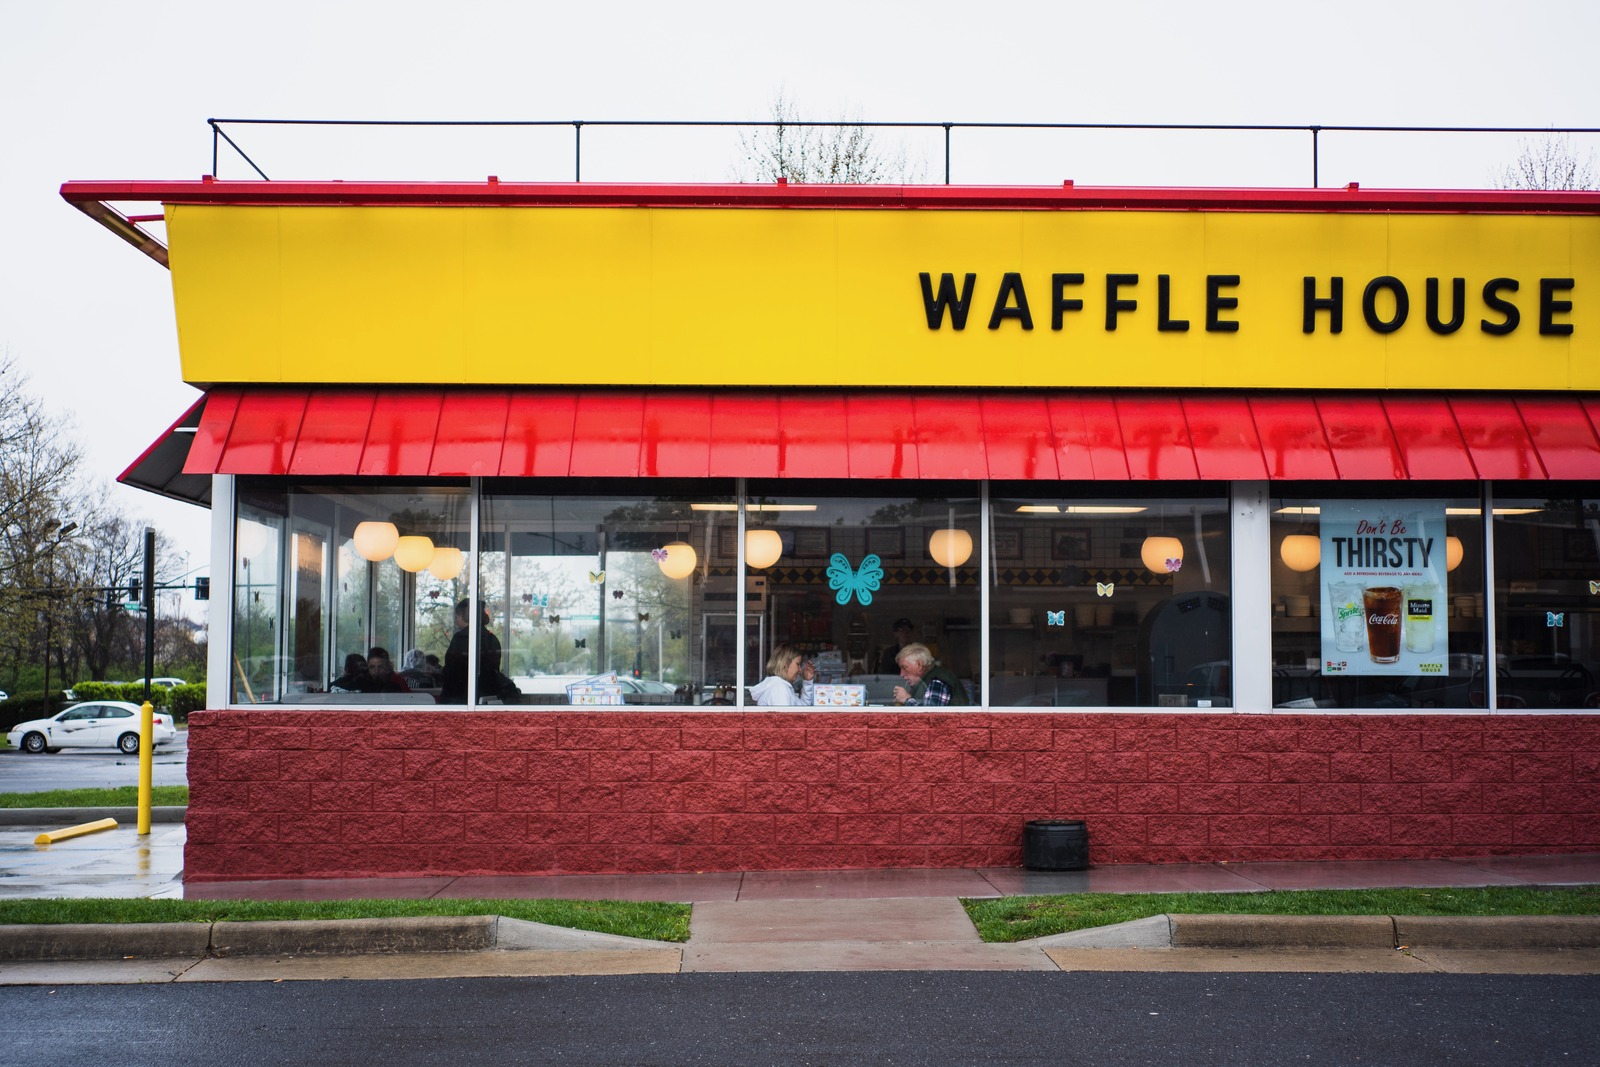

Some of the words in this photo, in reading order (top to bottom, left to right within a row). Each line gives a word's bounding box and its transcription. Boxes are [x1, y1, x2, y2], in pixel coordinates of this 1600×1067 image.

[919, 272, 1240, 333] WAFFLE
[1303, 276, 1575, 335] HOUSE
[1357, 519, 1387, 535] Don't
[1390, 519, 1406, 535] Be
[1332, 537, 1434, 568] THIRSTY
[1338, 606, 1359, 619] Sprite
